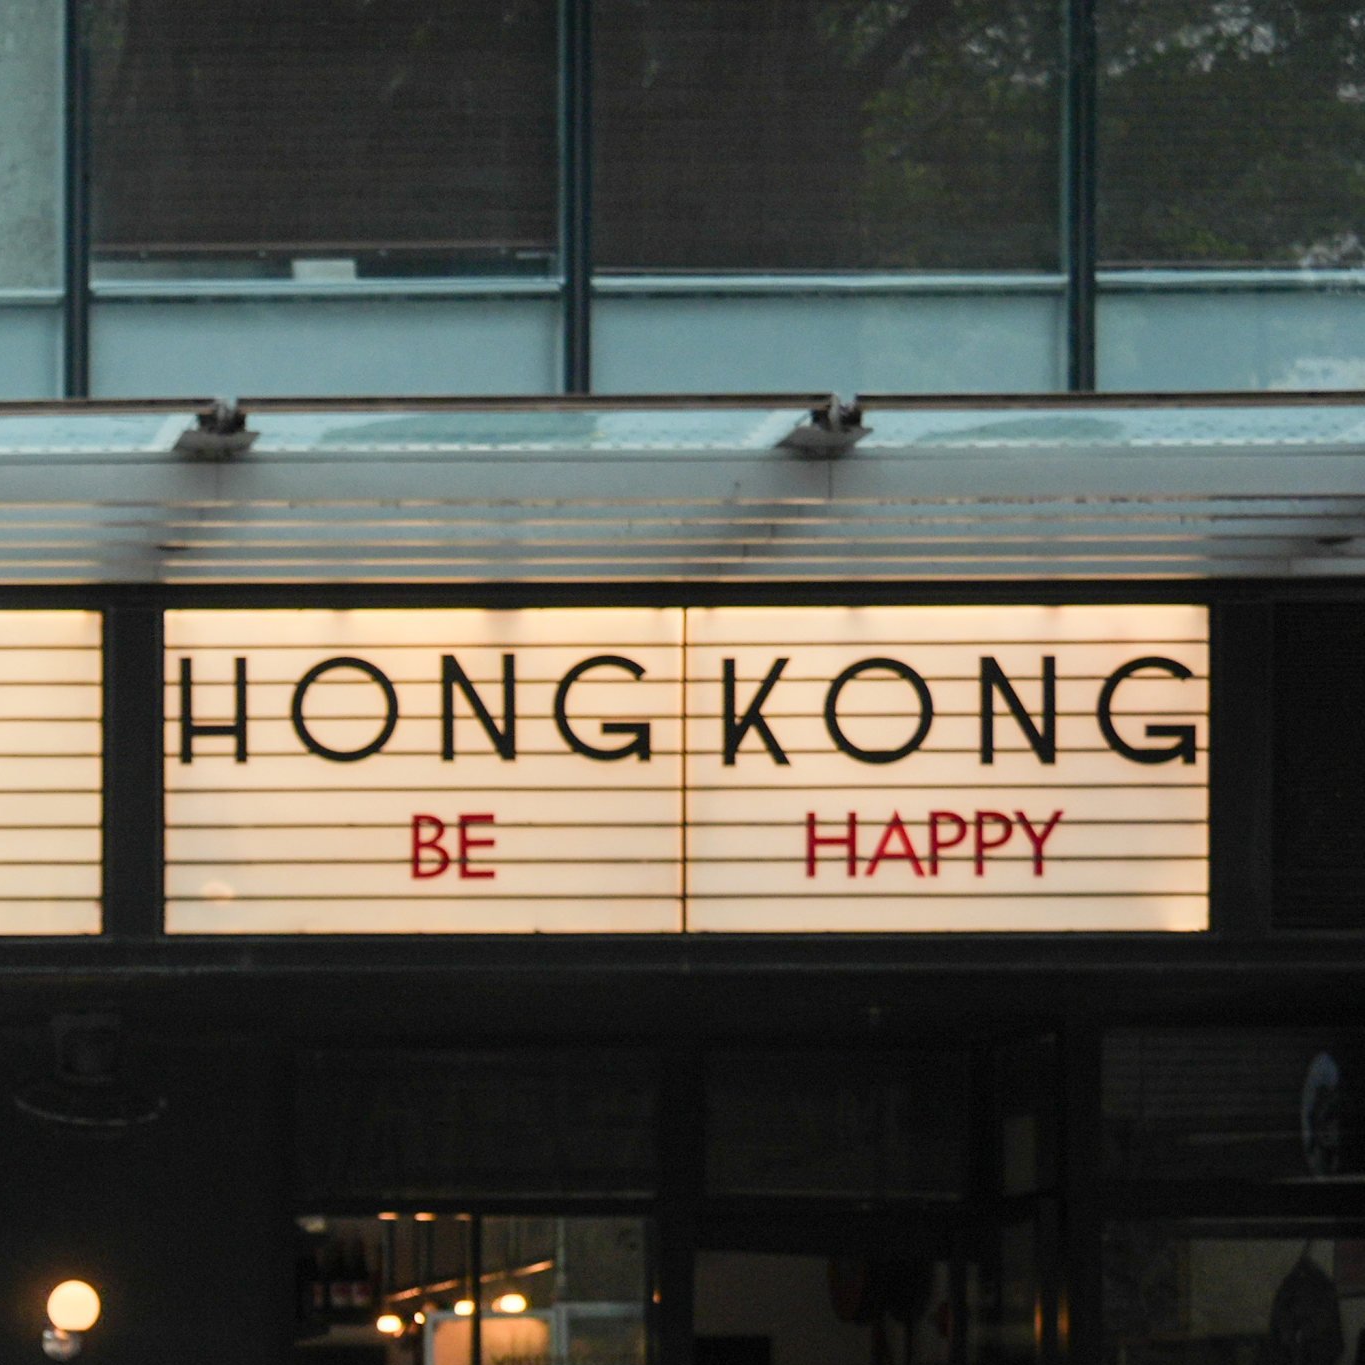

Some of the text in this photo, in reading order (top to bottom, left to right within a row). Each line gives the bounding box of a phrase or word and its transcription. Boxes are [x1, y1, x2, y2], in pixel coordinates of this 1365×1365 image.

[178, 653, 1197, 766] HONG KONG
[410, 809, 1065, 880] BE HAPPY
